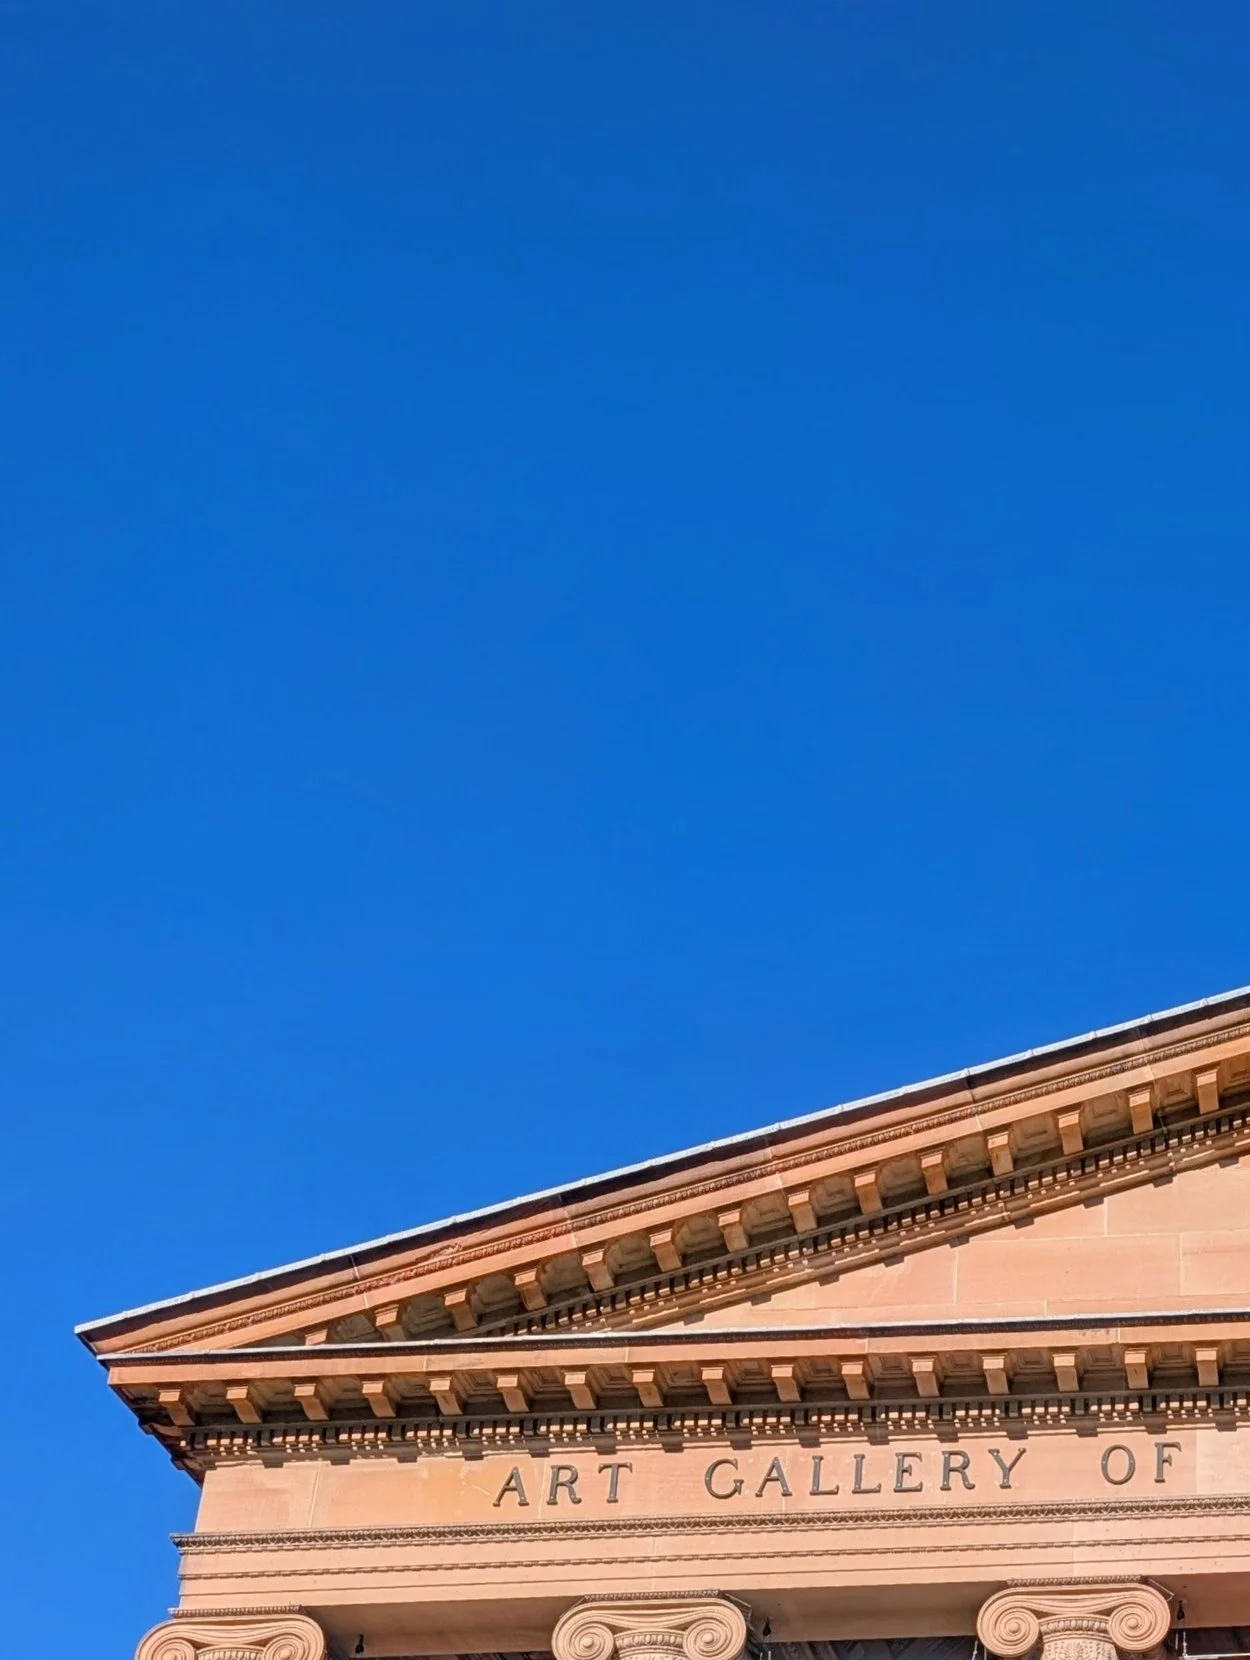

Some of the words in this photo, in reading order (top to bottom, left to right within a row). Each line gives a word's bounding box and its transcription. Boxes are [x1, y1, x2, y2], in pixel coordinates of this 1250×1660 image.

[493, 1461, 633, 1507] ART
[704, 1448, 1026, 1499] GALLERY
[1100, 1441, 1183, 1487] OF
